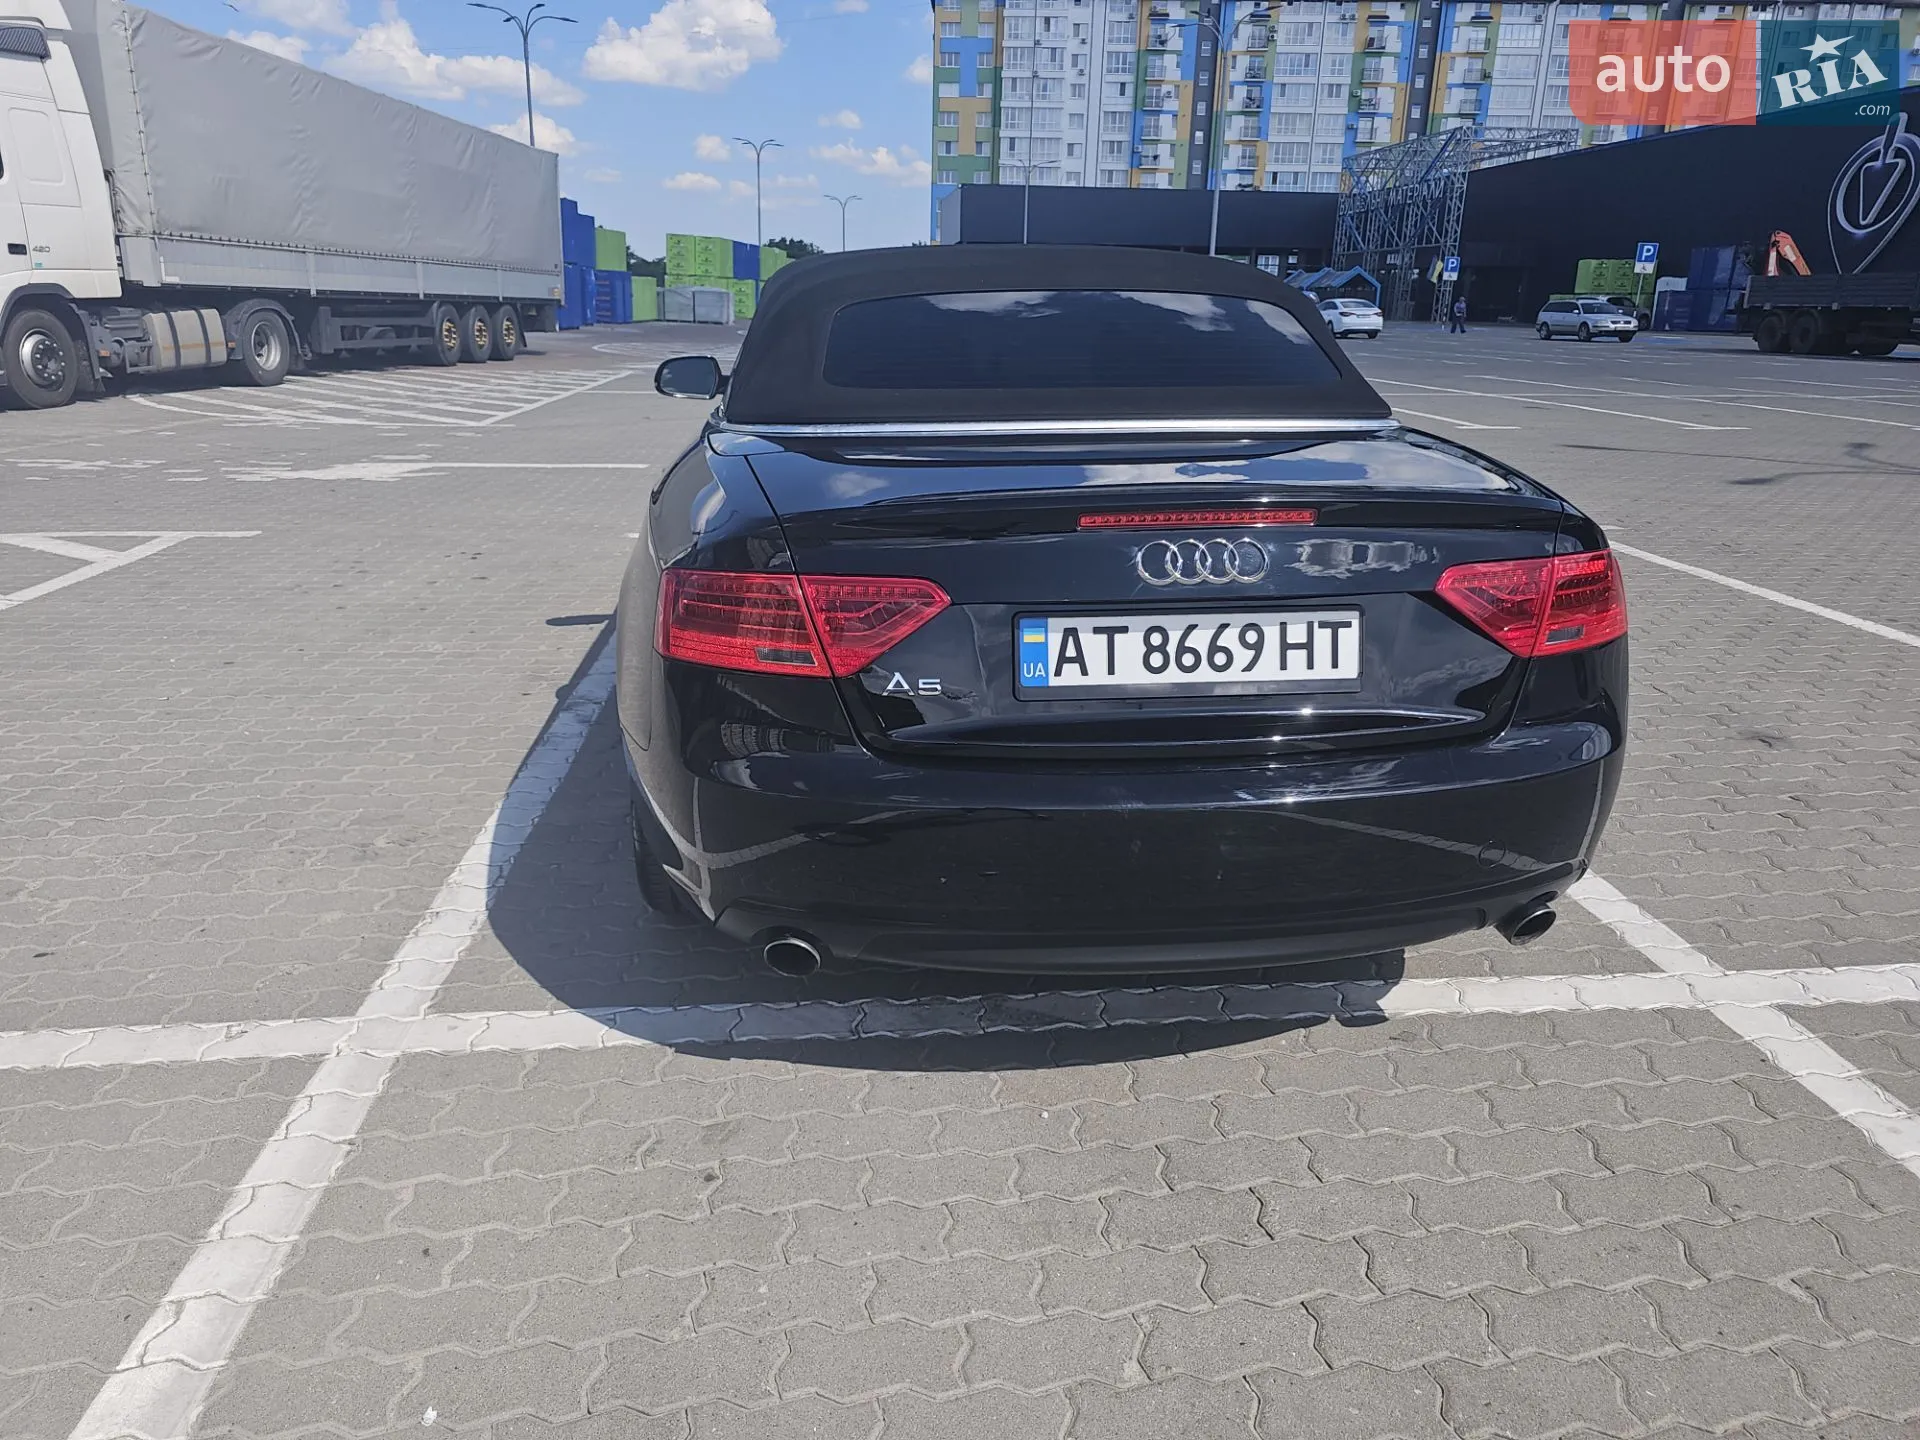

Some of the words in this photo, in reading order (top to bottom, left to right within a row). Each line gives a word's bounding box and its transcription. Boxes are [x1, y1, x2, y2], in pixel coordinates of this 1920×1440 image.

[1387, 179, 1445, 206] МАТЕРІАЛИ
[1641, 245, 1655, 261] P
[1447, 258, 1457, 271] P
[1053, 625, 1130, 677] AT
[1142, 622, 1266, 675] 8669
[1278, 619, 1353, 671] HT
[1023, 662, 1046, 678] UA
[881, 671, 942, 696] A5
